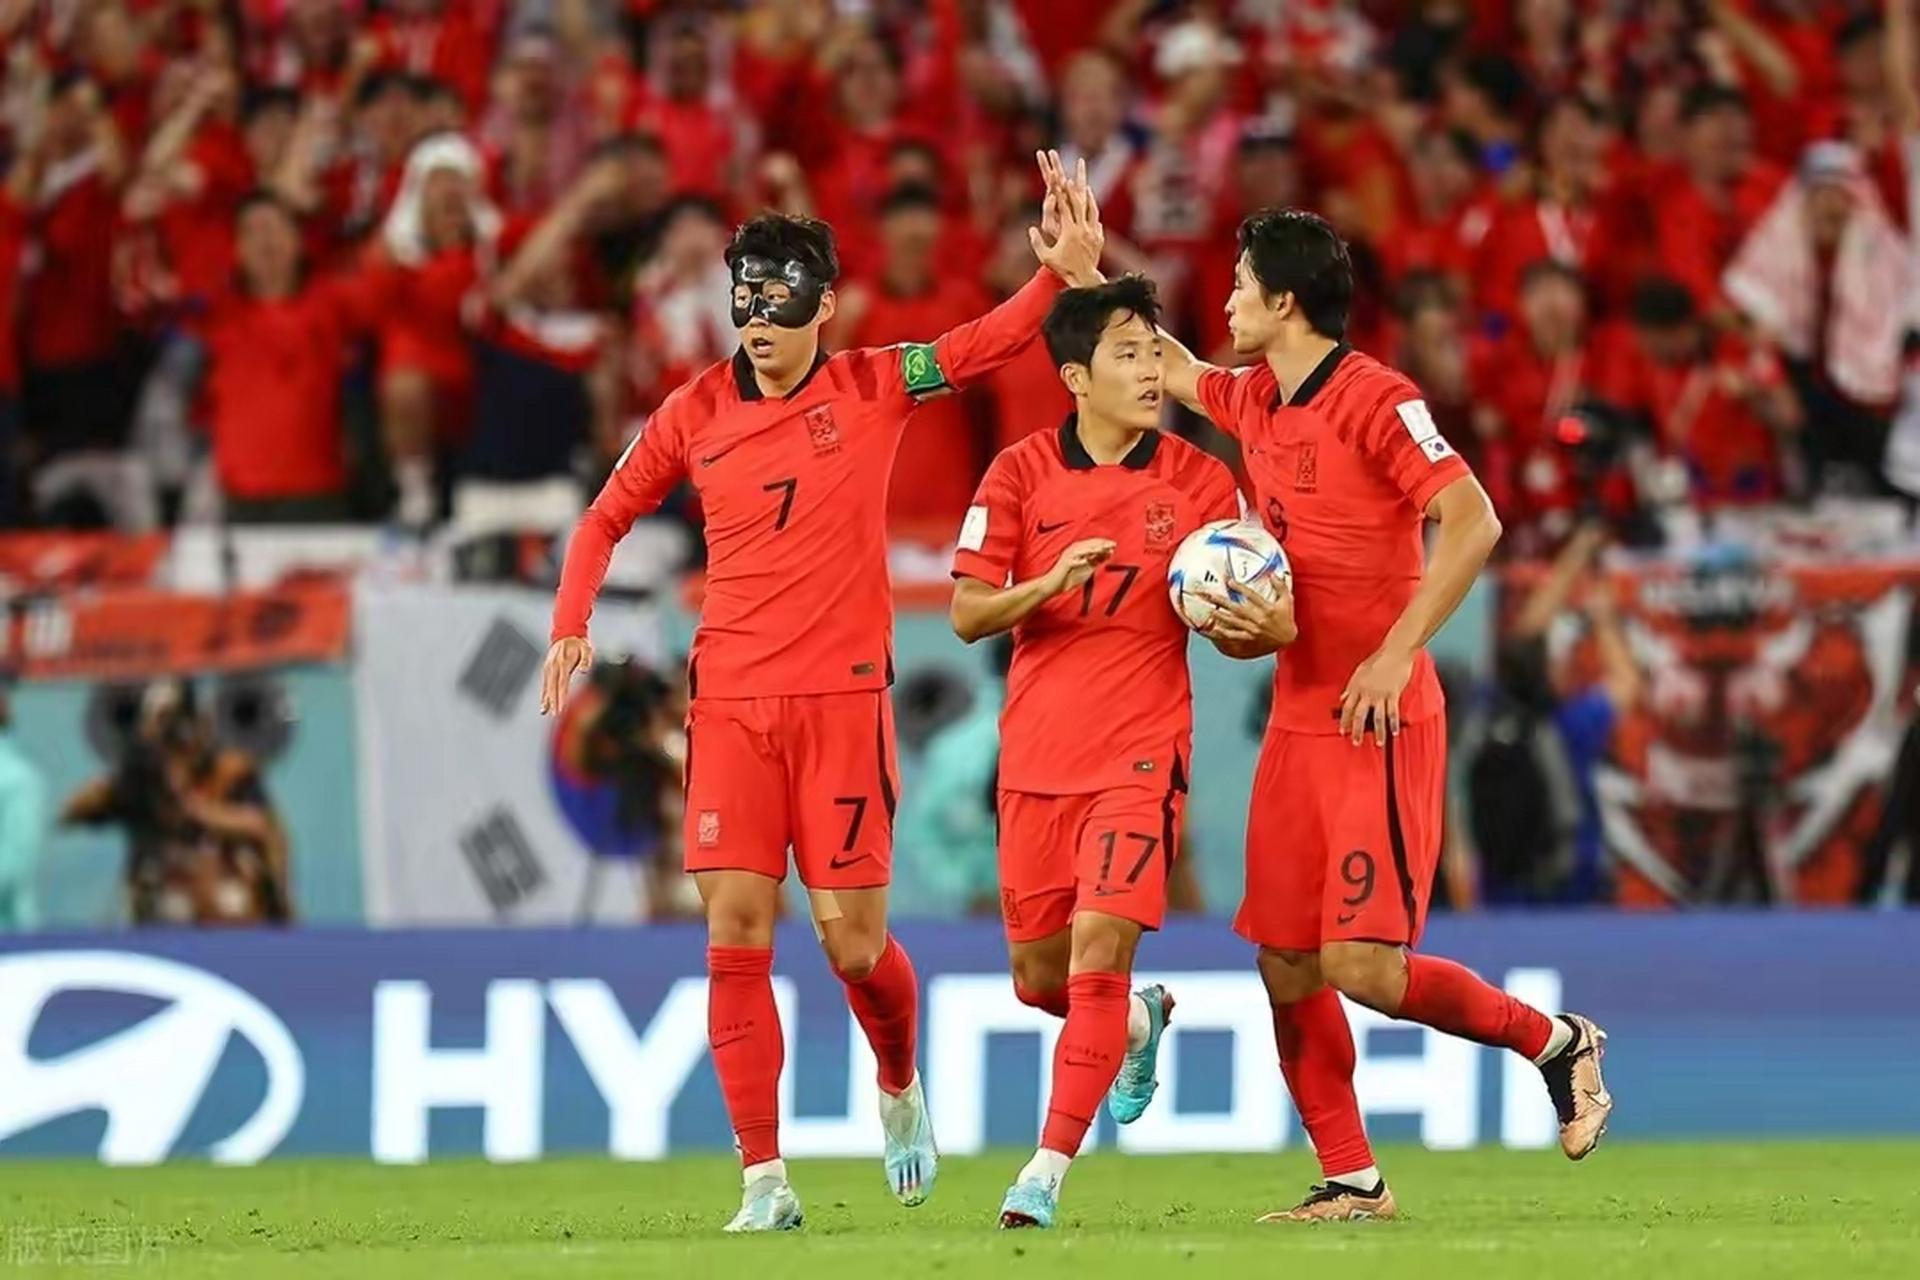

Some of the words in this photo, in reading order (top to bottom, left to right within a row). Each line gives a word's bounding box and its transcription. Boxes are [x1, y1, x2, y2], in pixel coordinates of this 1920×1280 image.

[762, 477, 797, 531] 7
[1079, 564, 1141, 618] 17
[834, 796, 868, 851] 7
[1098, 830, 1160, 885] 17
[1340, 850, 1375, 907] 9
